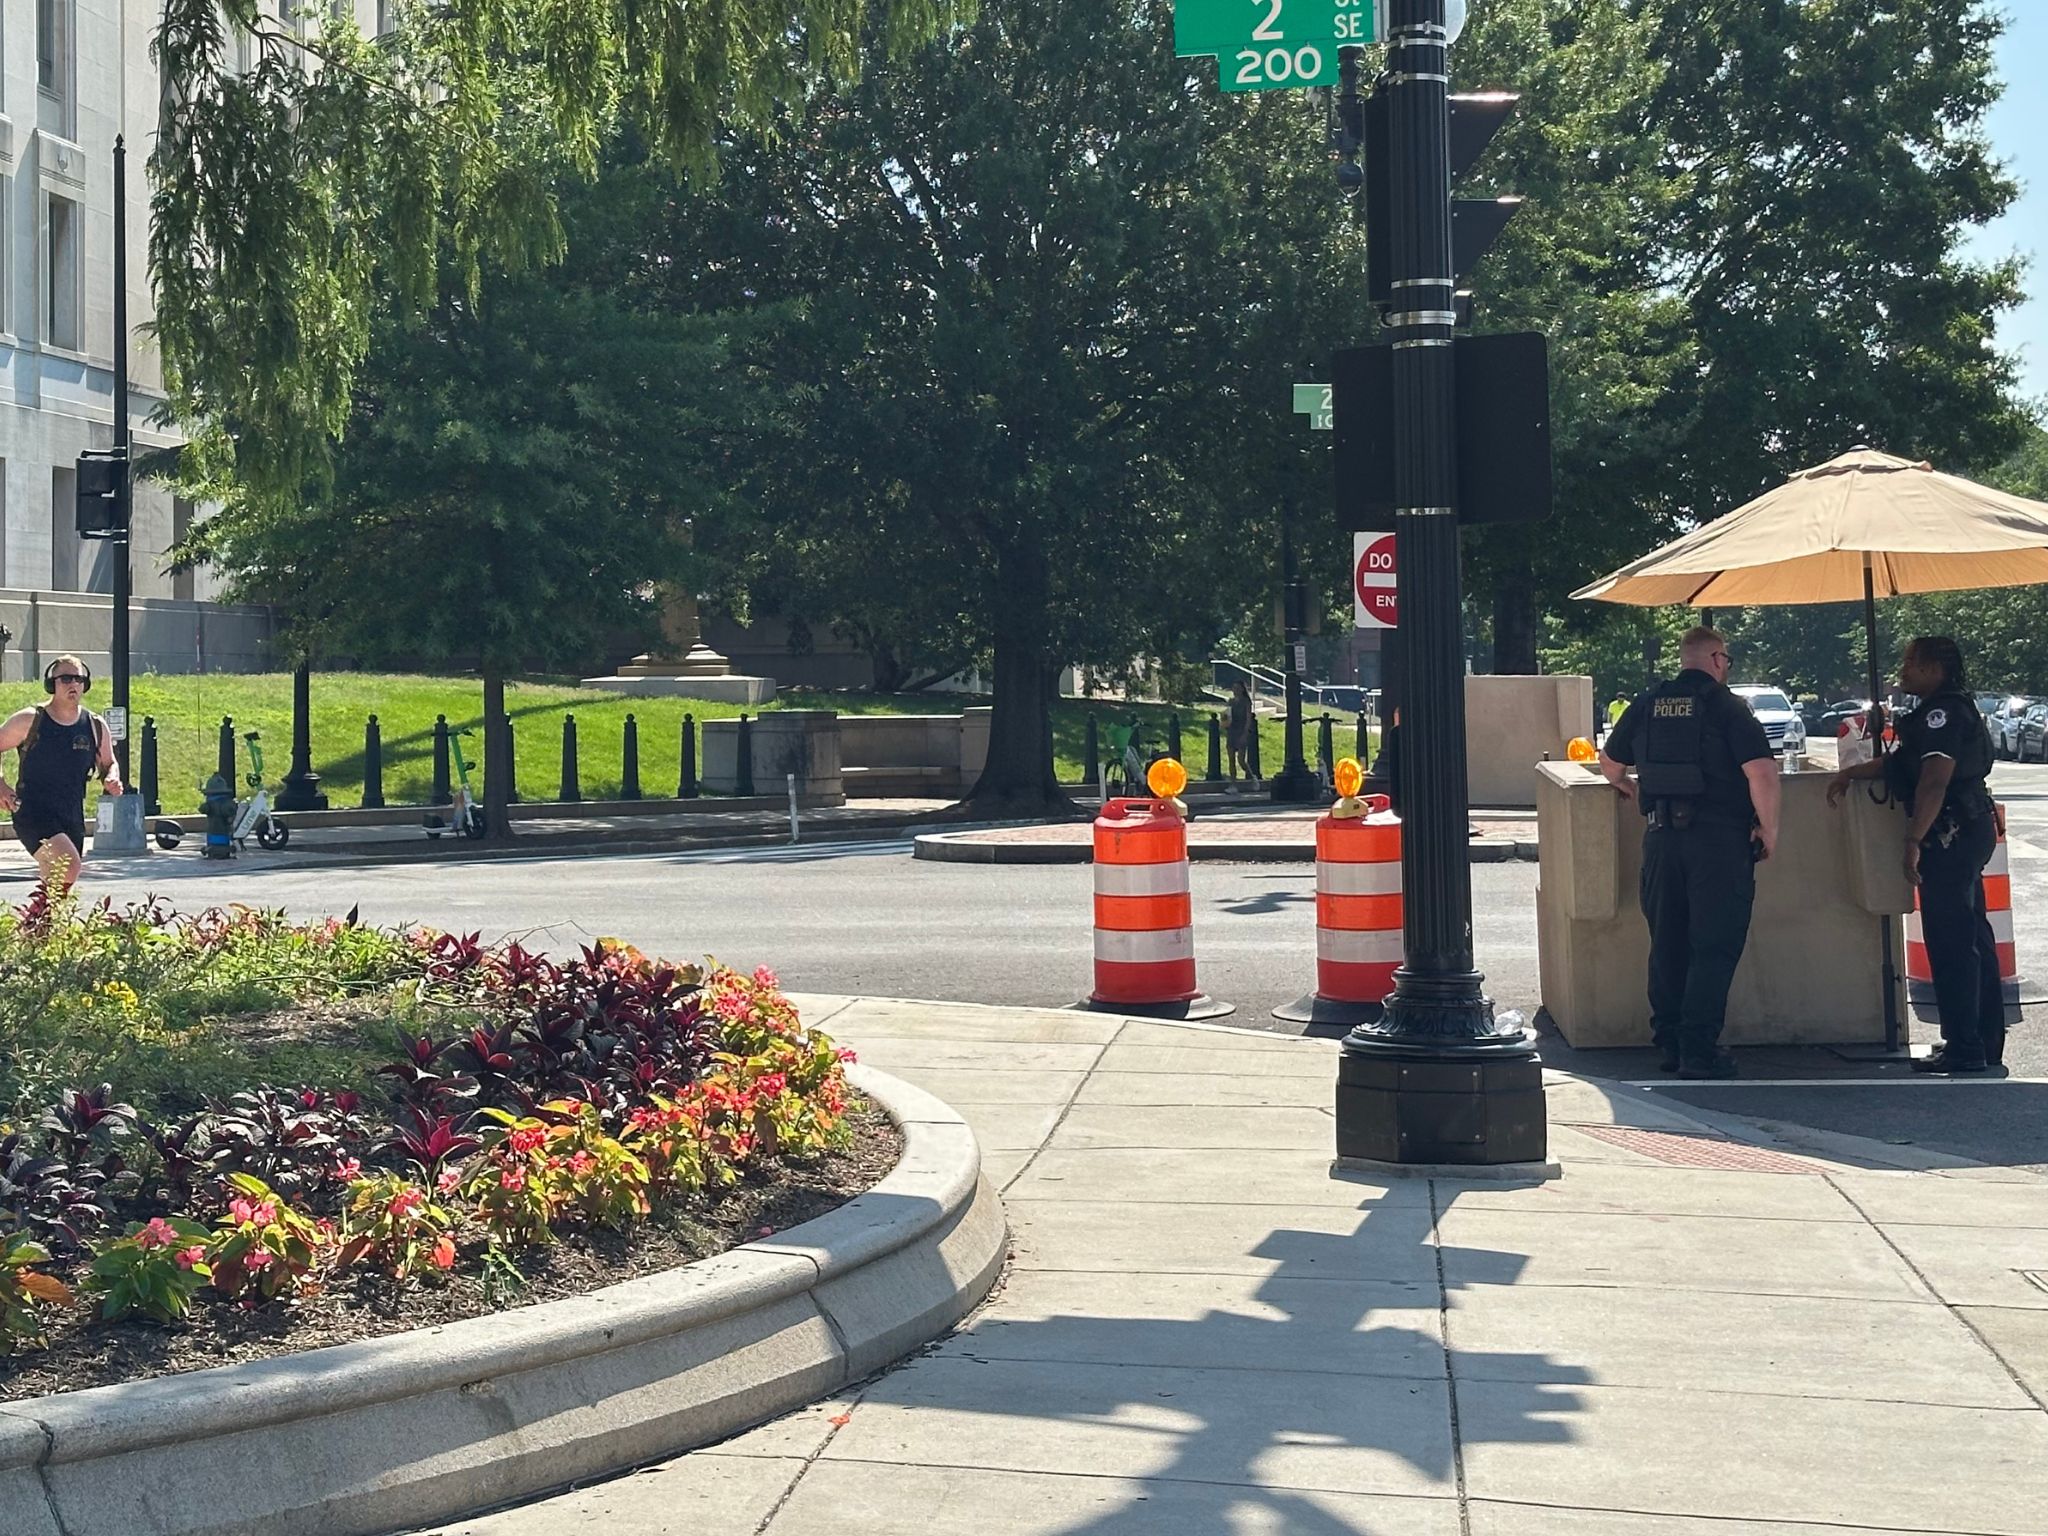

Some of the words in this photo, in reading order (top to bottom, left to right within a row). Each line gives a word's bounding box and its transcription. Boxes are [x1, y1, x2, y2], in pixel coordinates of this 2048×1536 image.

[1252, 0, 1284, 40] 2
[1333, 12, 1364, 39] SE
[1235, 46, 1322, 84] 200
[1369, 552, 1392, 569] DO
[1376, 594, 1397, 607] EN
[1653, 704, 1693, 717] POLICE
